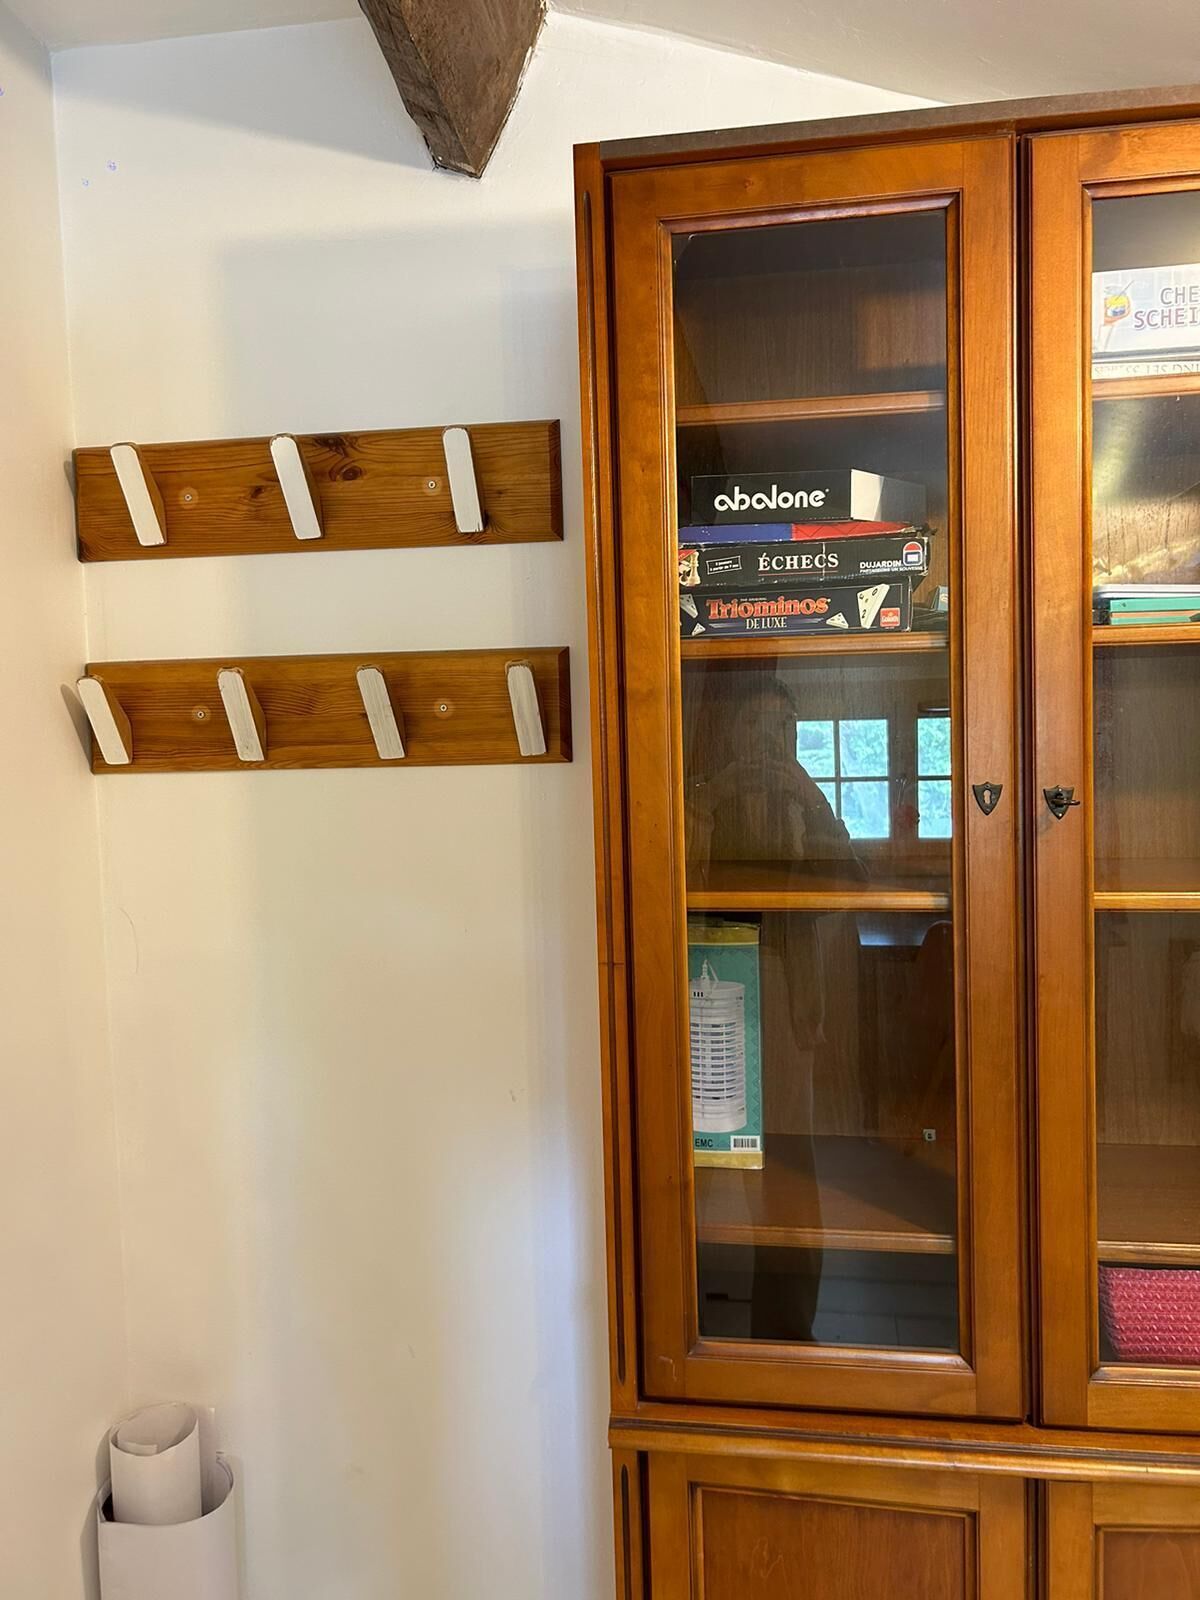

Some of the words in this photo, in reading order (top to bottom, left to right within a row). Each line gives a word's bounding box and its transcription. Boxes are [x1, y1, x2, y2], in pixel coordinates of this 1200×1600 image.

[714, 484, 826, 511] abalone
[758, 552, 839, 571] ÉCHECS
[860, 560, 902, 569] DUJARDIN
[706, 595, 829, 619] Triominos
[695, 1138, 713, 1148] EMC
